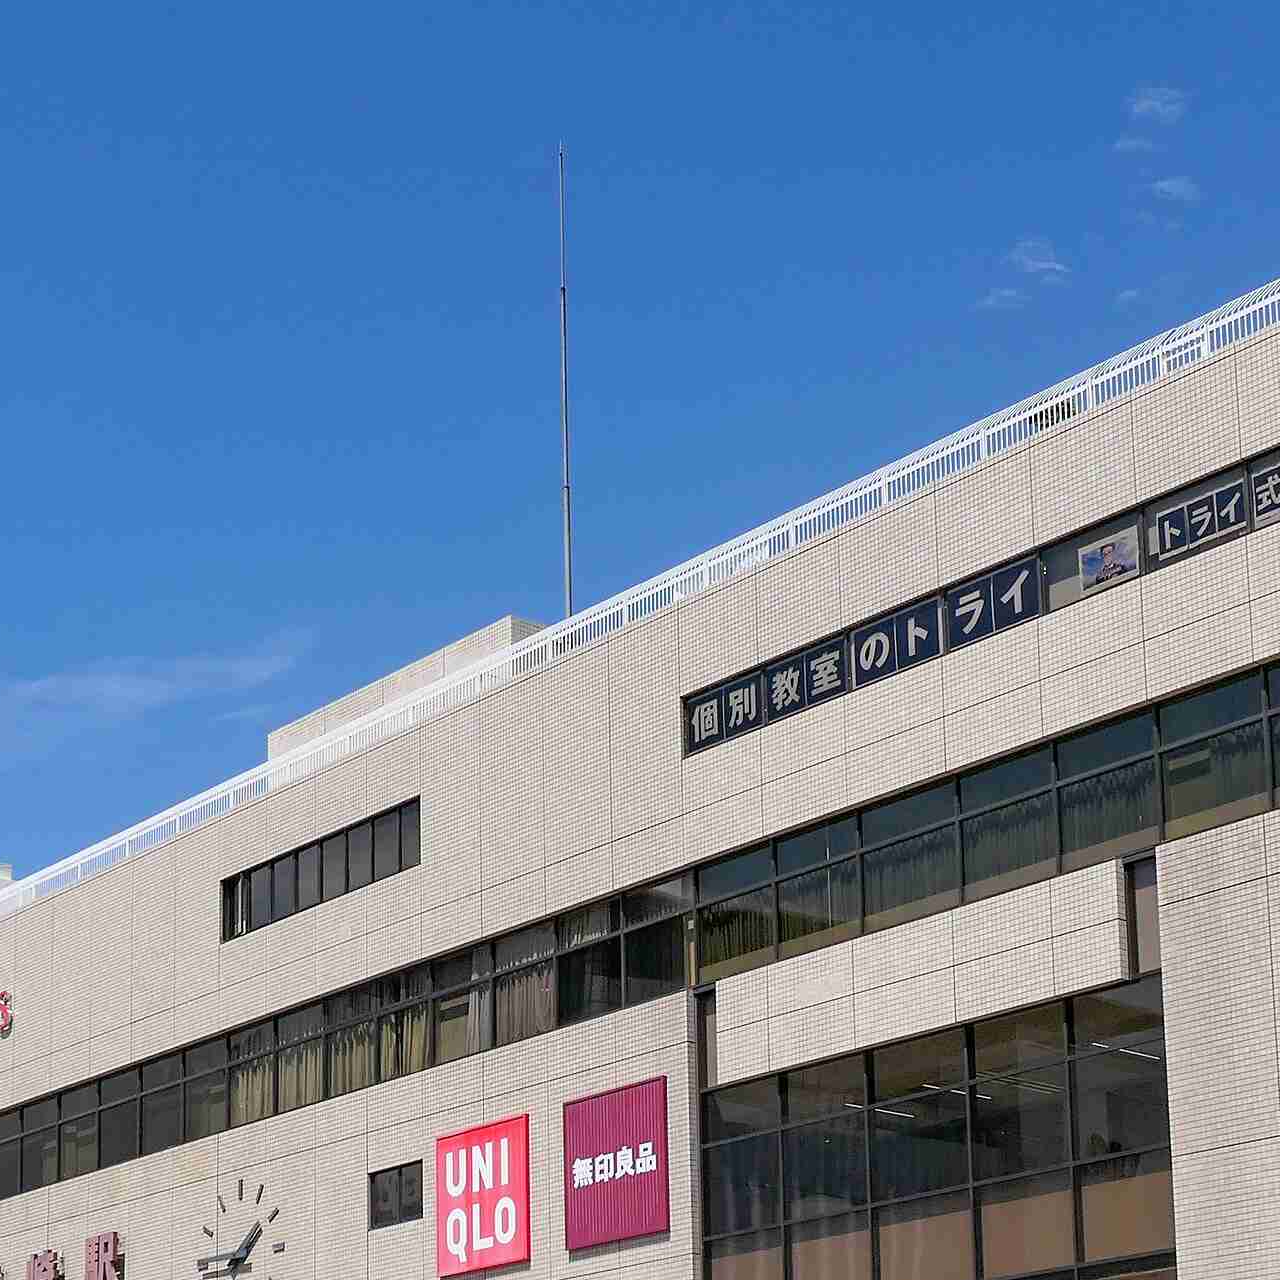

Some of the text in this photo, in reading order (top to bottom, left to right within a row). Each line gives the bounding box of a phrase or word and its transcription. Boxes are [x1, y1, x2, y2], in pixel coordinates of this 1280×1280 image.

[691, 569, 1030, 743] 個別教室のトライ
[445, 1138, 510, 1197] UNI
[572, 1142, 657, 1189] 無印良品
[446, 1197, 516, 1263] QLO
